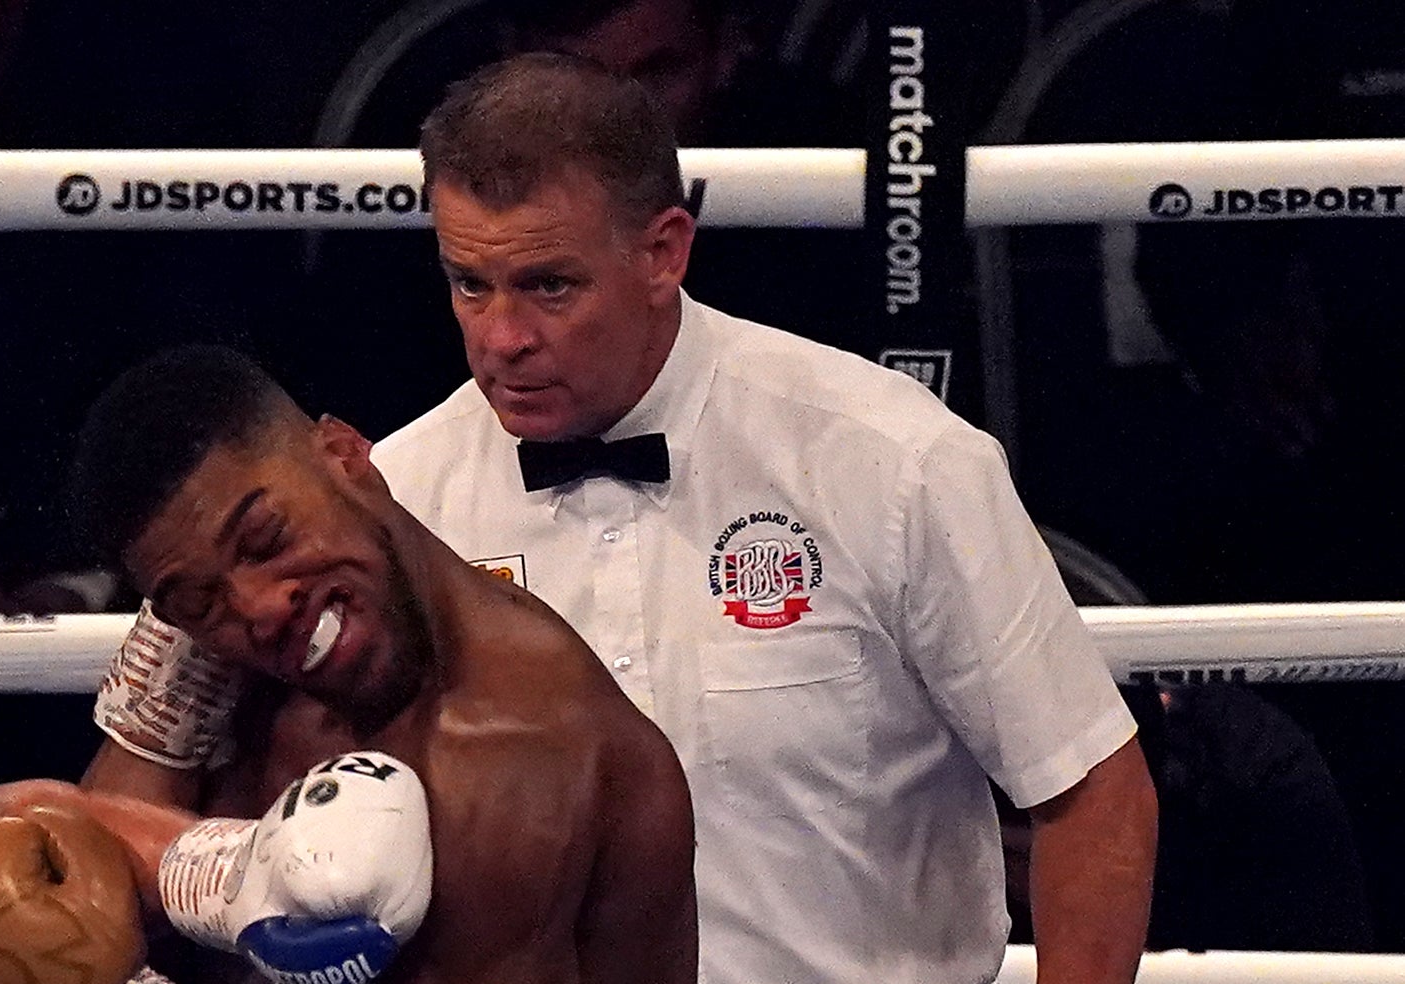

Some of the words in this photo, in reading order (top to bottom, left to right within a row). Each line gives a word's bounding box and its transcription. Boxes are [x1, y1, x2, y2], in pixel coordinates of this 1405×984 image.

[111, 181, 431, 213] JDSPORTS.CO
[714, 516, 748, 552] BOXING
[749, 511, 789, 526] BOARD
[790, 521, 807, 536] OF
[803, 537, 823, 590] CONTROL
